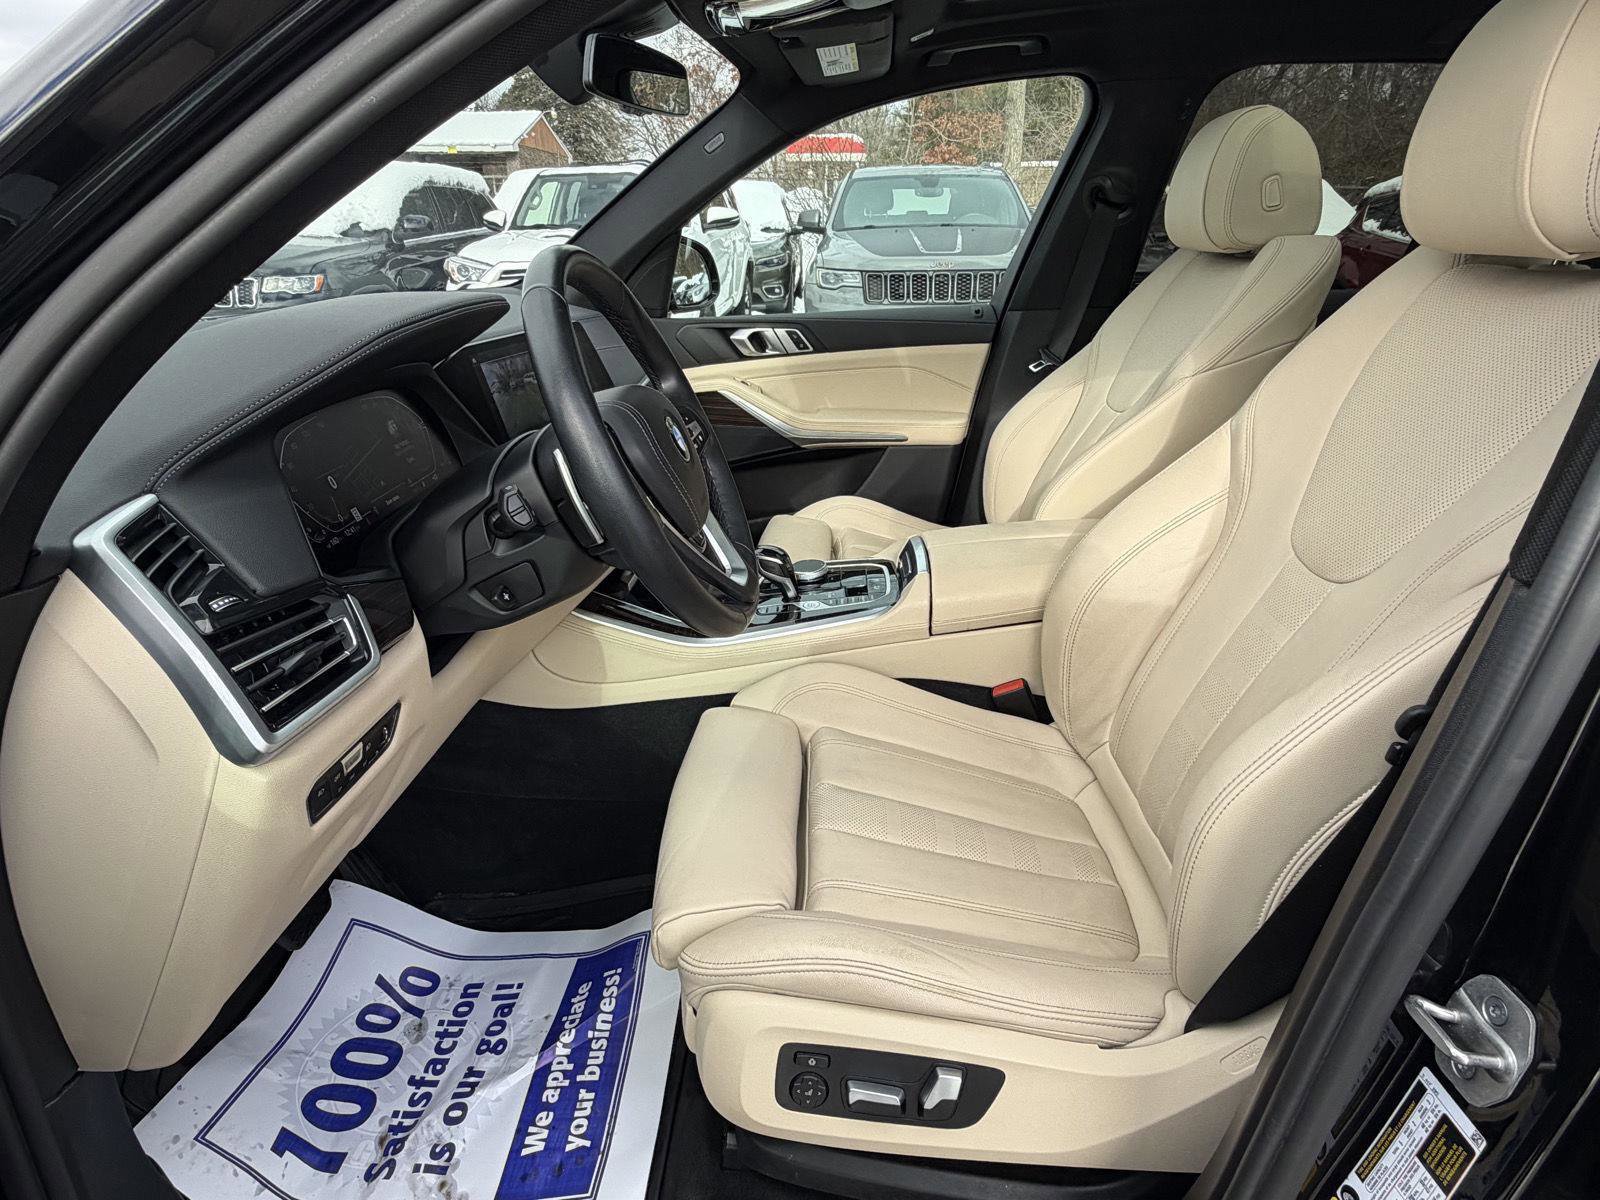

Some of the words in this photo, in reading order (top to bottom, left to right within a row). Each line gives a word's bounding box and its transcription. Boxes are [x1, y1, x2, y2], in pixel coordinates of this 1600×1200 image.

[269, 965, 441, 1175] 100%
[363, 982, 485, 1183] Satisfaction
[411, 1141, 456, 1176] is
[442, 1065, 486, 1127] our
[475, 981, 525, 1057] goal!
[520, 1110, 554, 1157] We
[541, 980, 594, 1104] appreciate
[576, 966, 623, 1083] business!
[564, 1088, 596, 1153] your
